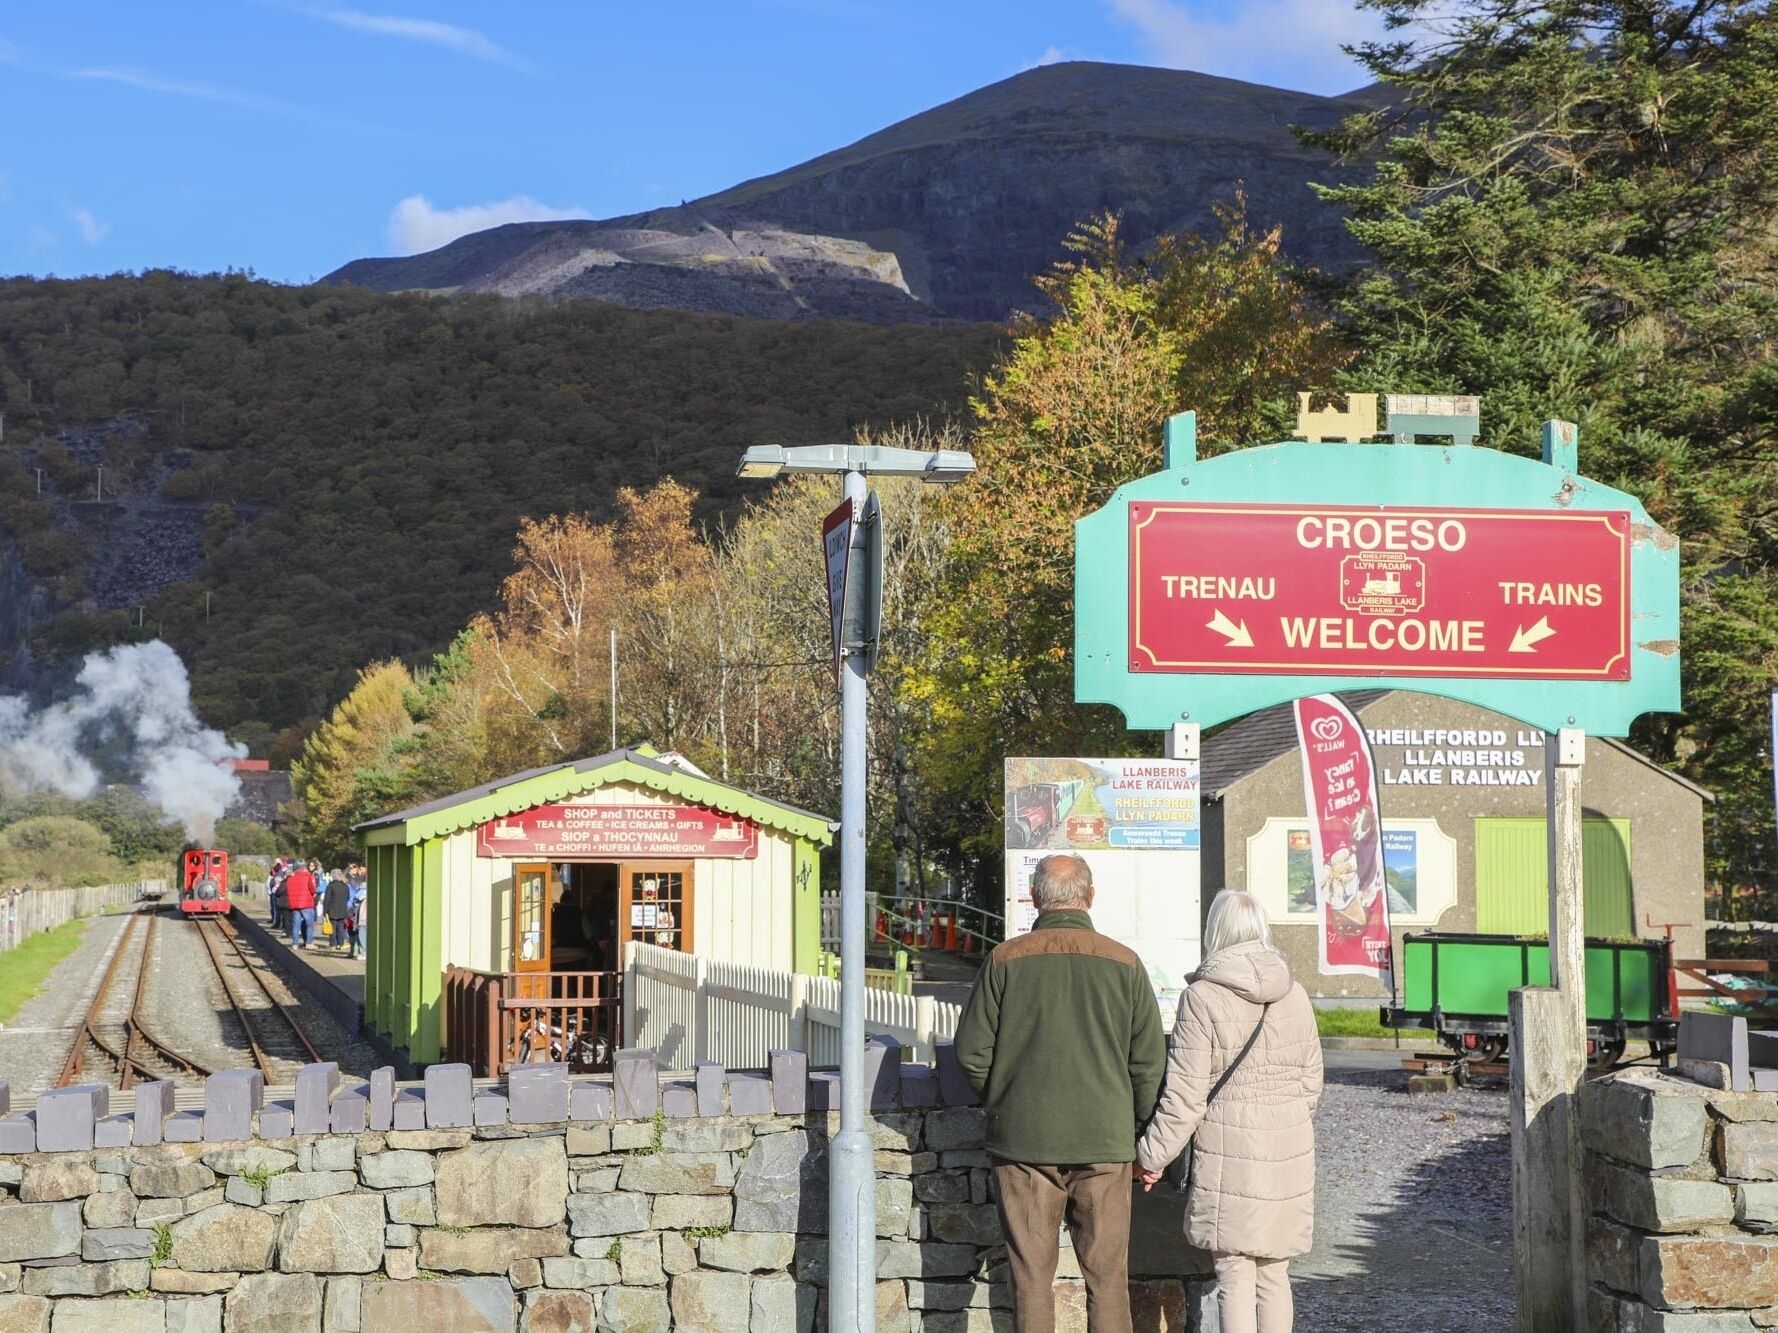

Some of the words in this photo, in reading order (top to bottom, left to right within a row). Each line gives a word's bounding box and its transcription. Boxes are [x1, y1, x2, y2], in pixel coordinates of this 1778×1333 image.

[1296, 517, 1467, 551] CROESO
[1353, 562, 1375, 570] LLYN
[1377, 562, 1412, 571] PADARN
[1161, 575, 1276, 600] TRENAU
[1499, 581, 1603, 607] TRAINS
[1347, 596, 1393, 605] LLANBERIS
[1395, 597, 1418, 606] LAKE
[1280, 617, 1486, 653] WELCOME
[1366, 729, 1507, 746] RHEILFFORDD
[1404, 750, 1526, 766] LLANBERIS
[1122, 767, 1187, 777] LLANBERIS
[1383, 769, 1443, 785] LAKE
[1450, 769, 1543, 785] RAILWAY
[1112, 780, 1142, 790] LAKE
[1146, 781, 1197, 790] RAILWAY
[564, 808, 598, 819] SHOP
[600, 809, 622, 819] and
[625, 809, 676, 820] TICKETS
[1115, 810, 1145, 821] LLYN
[1149, 811, 1194, 822] PADARN
[535, 820, 556, 829] TEA
[556, 820, 564, 829] &
[566, 820, 604, 829] COFFEE
[611, 820, 627, 829] ICE
[629, 820, 669, 830] CREAMS
[676, 821, 704, 830] GIFTS
[561, 832, 590, 842] SIOP
[593, 834, 600, 842] a
[603, 832, 678, 843] THOCYNNAU
[534, 843, 546, 852] TE
[556, 843, 591, 852] CHOFFI
[598, 844, 630, 852] HUFEN
[650, 844, 705, 853] ANRHEGION
